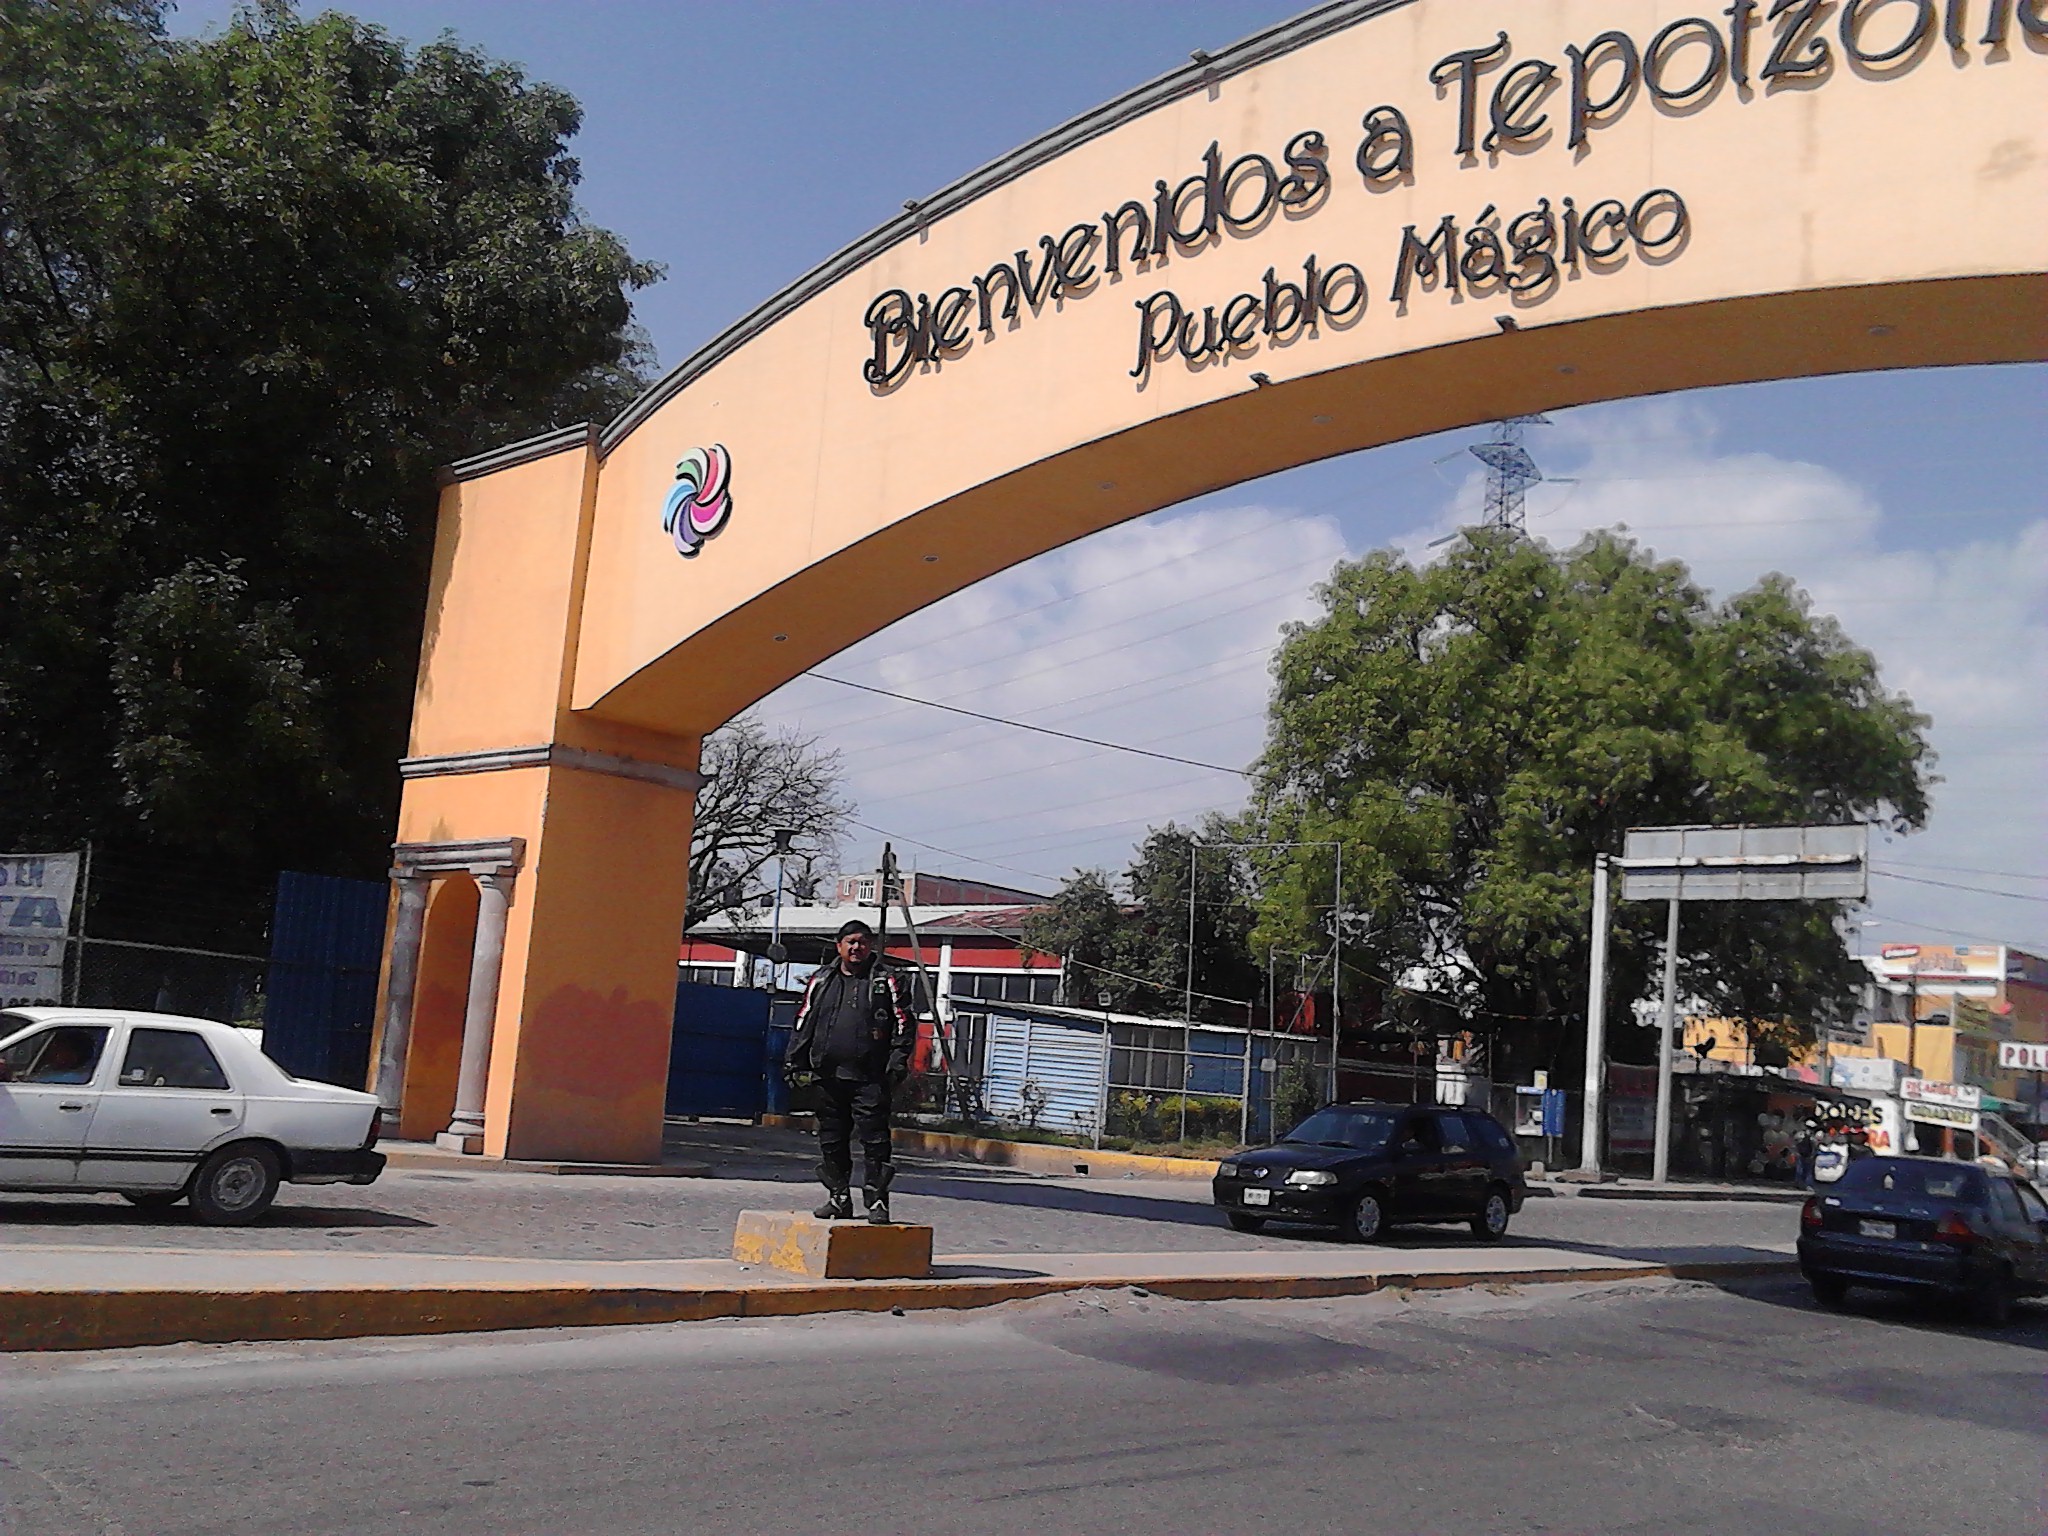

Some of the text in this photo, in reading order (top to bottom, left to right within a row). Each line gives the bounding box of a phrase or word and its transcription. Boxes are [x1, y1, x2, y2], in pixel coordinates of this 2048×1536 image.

[864, 0, 2048, 384] Bienvenidos a Tepotzo
[1130, 188, 1687, 378] Pueblo Mágico
[2004, 1045, 2048, 1068] POL
